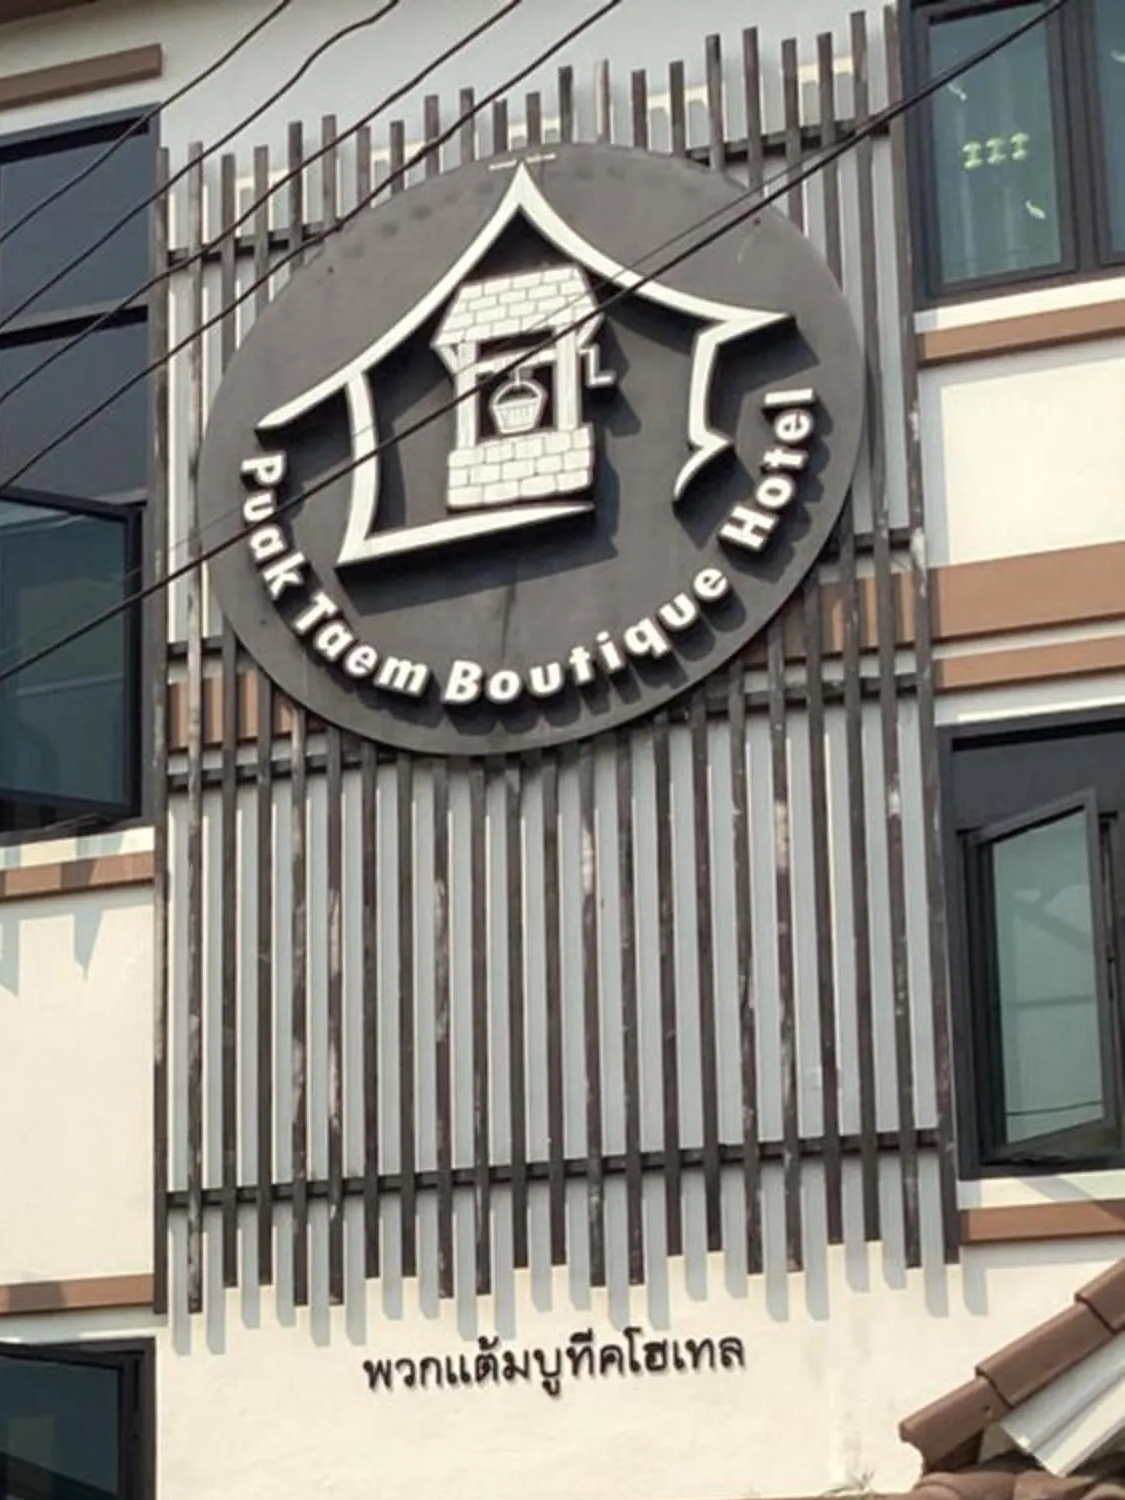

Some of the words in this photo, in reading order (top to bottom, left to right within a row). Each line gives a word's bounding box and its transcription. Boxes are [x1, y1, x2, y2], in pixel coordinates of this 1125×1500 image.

[241, 451, 305, 599] Puak
[294, 592, 429, 696] Taem
[443, 566, 728, 703] Boutique
[720, 388, 815, 550] Hotel
[362, 1326, 745, 1397] พวกแต้มบูทีคโฮเทล
